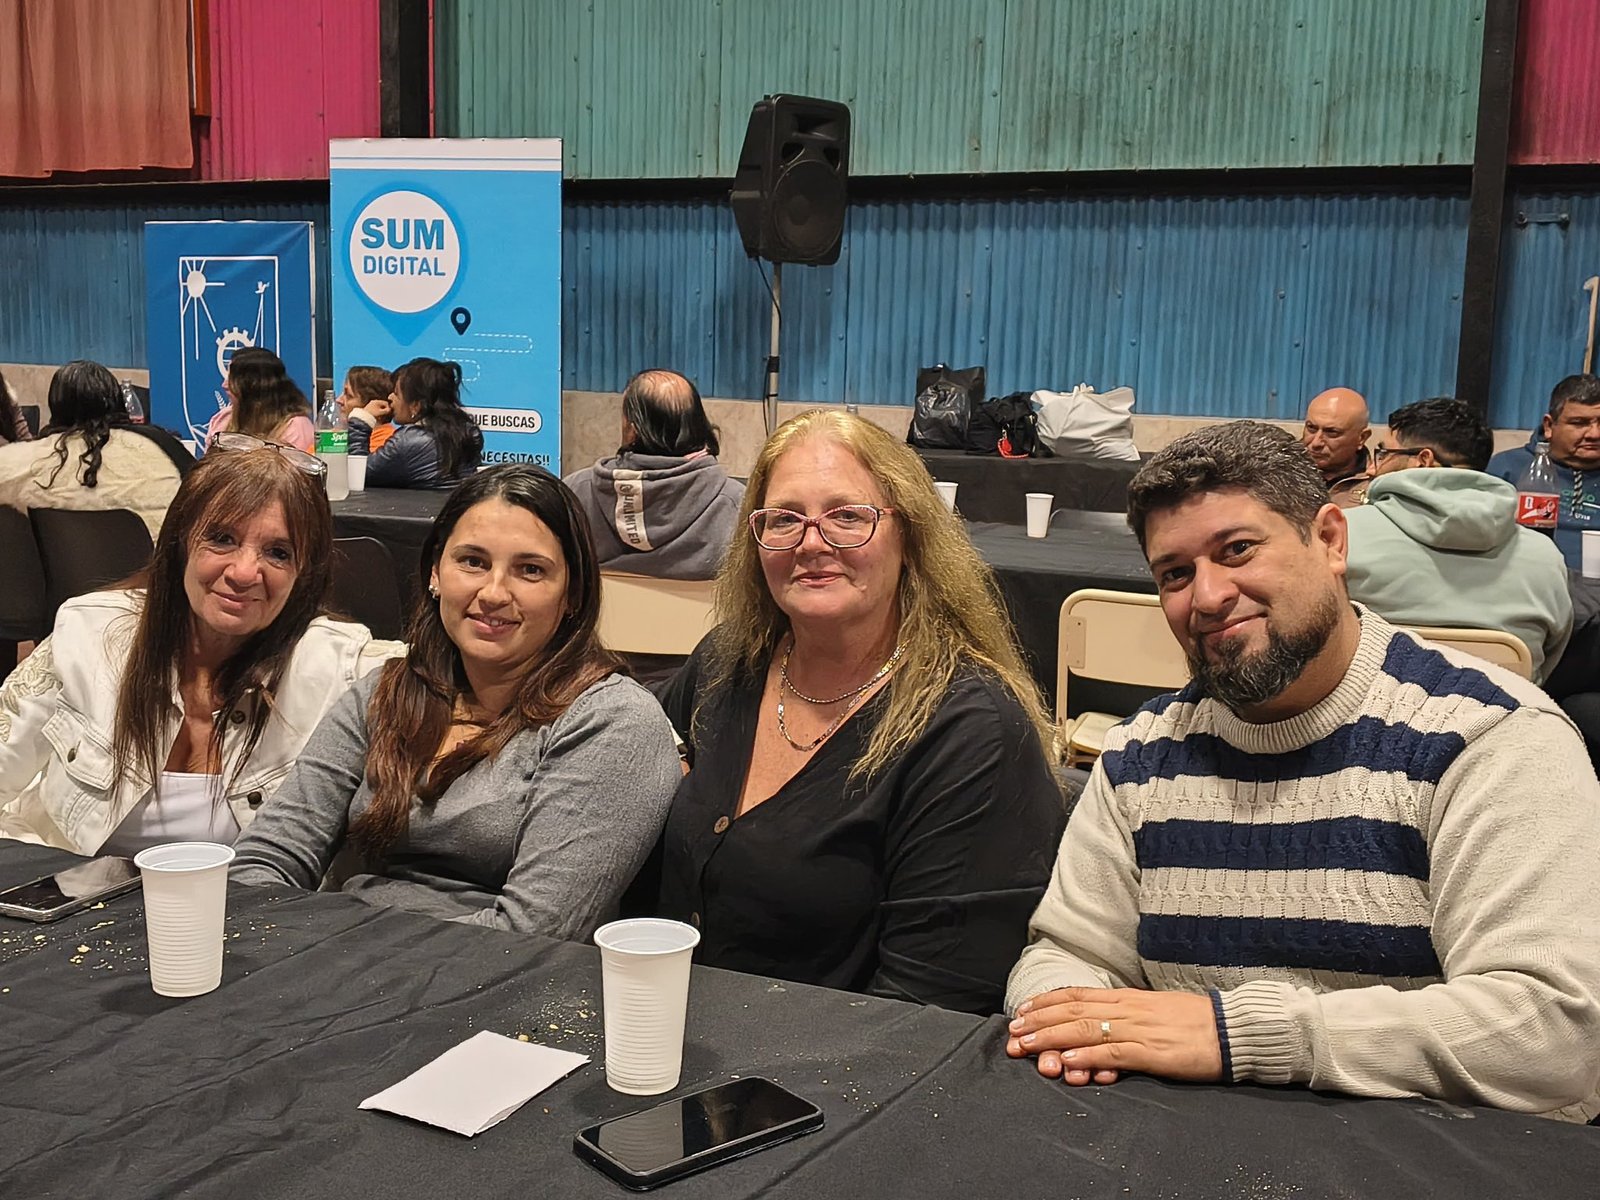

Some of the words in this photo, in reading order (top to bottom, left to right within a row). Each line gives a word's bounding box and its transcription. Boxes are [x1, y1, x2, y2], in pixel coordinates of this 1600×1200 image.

[361, 217, 445, 251] SUM
[363, 255, 446, 276] DIGITAL
[491, 415, 535, 428] BUSCAS
[331, 433, 348, 442] Spri
